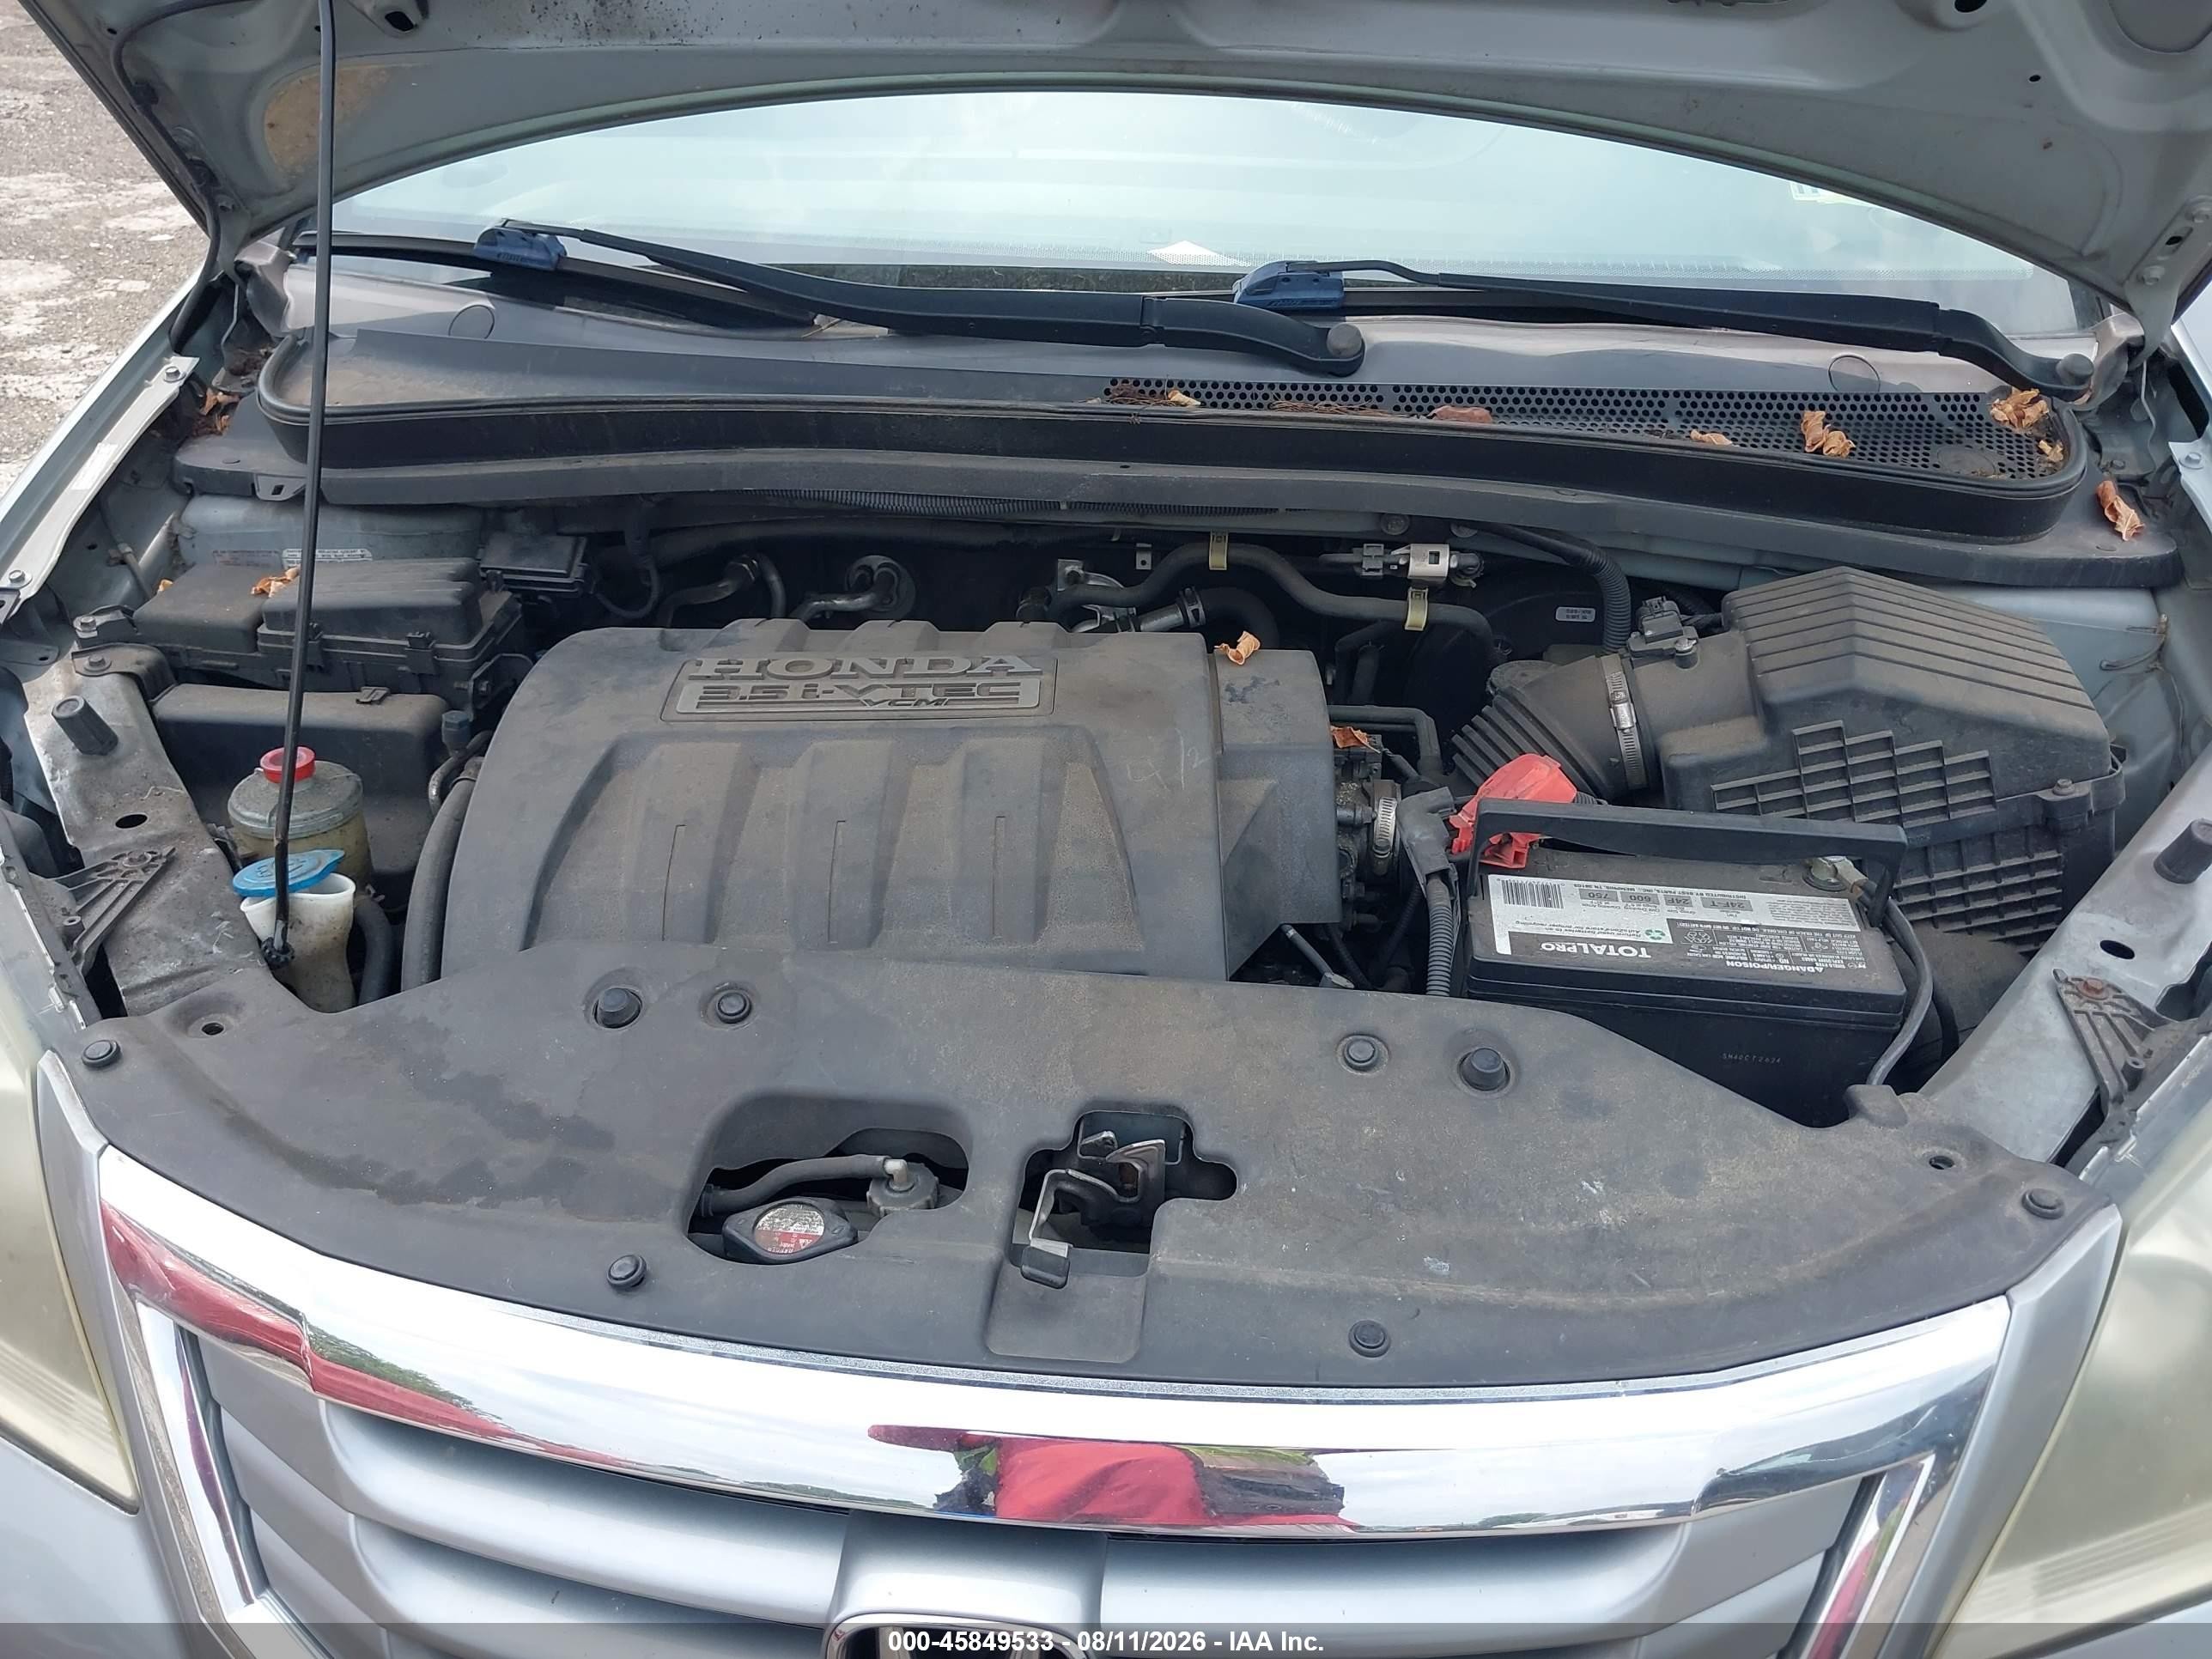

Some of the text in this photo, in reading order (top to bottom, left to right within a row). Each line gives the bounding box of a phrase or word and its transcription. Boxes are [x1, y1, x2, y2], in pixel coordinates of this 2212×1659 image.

[688, 655, 1043, 680] HONDA
[698, 682, 1022, 701] 3.5 i-VTEC
[863, 698, 949, 708] VCM
[1541, 941, 1652, 959] TOTALPRO
